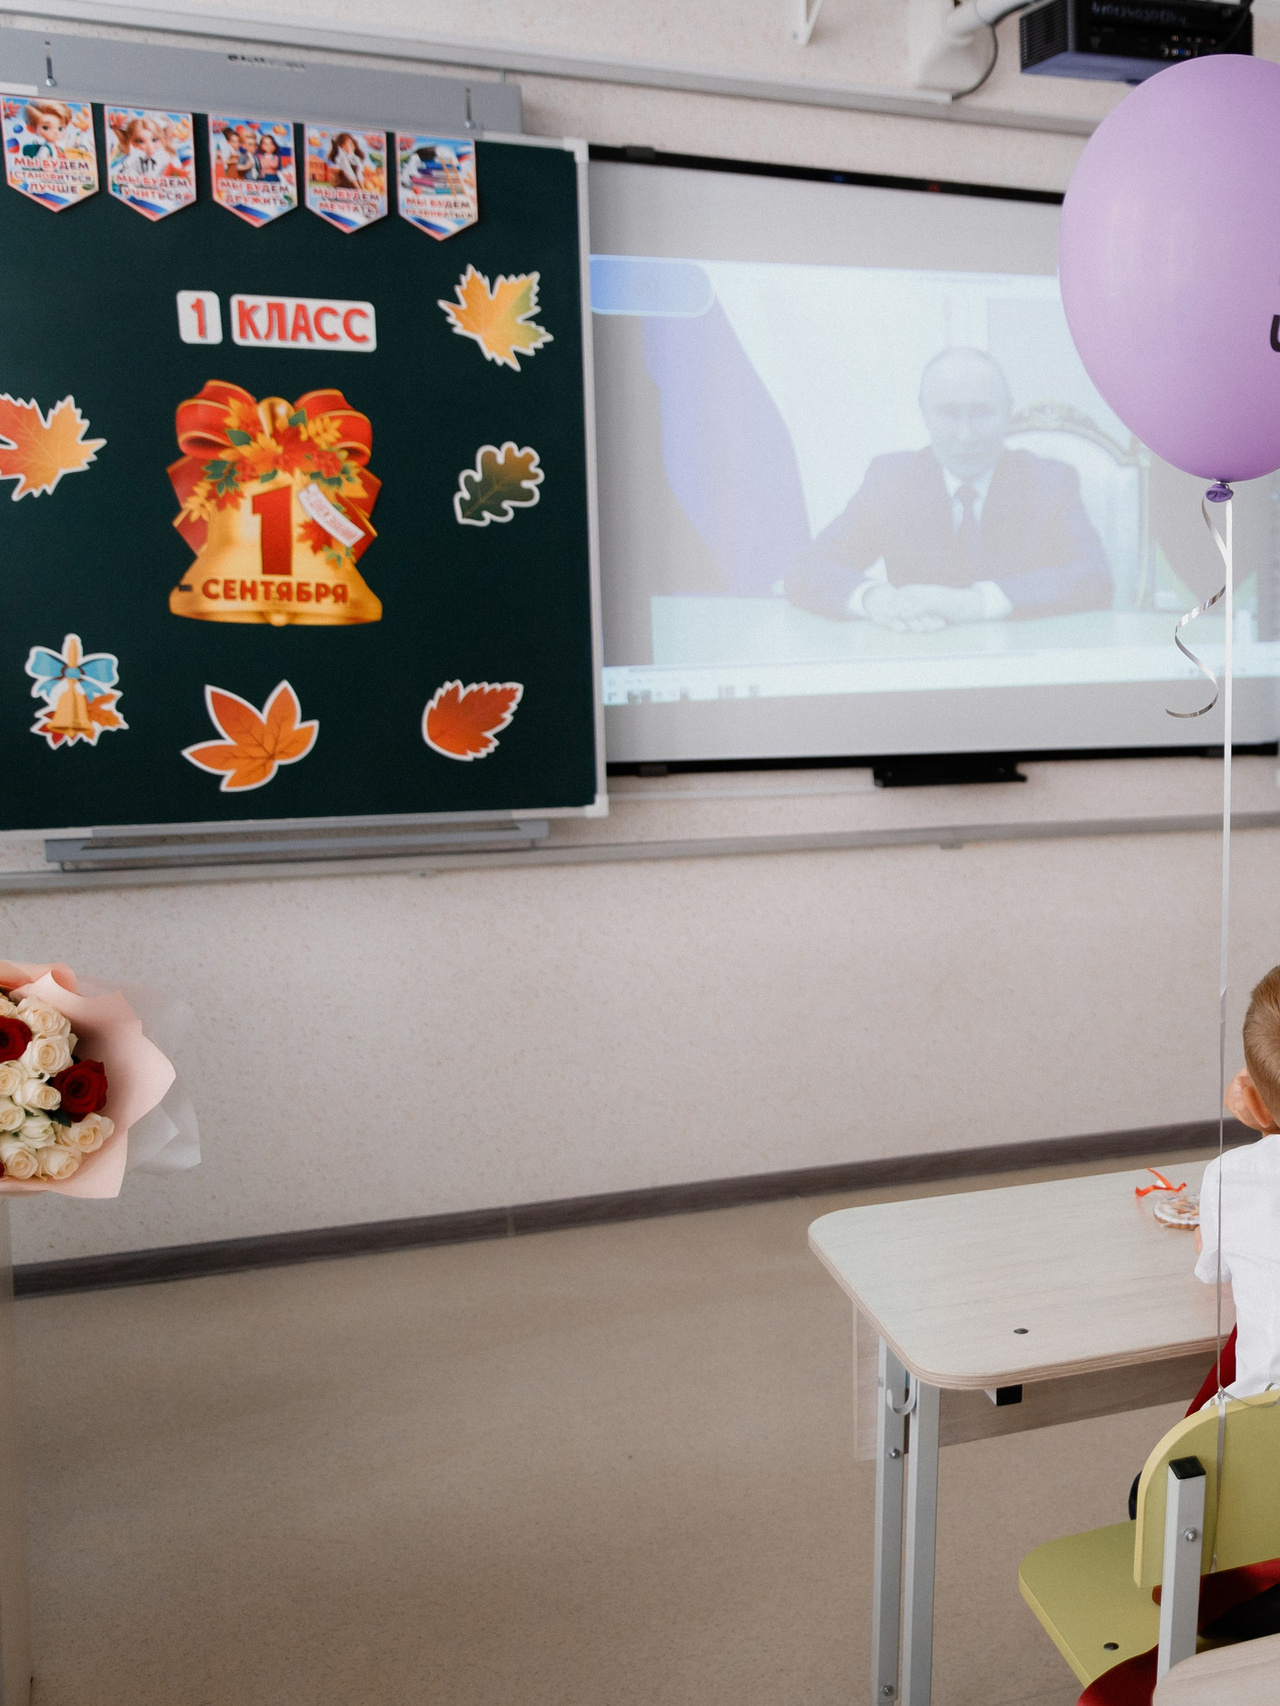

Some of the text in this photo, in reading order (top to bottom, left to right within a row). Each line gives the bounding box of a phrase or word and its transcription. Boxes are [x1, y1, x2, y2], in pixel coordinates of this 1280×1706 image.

[14, 157, 90, 170] МЫ БУДЕМ
[116, 174, 189, 188] МЫ БУДЕМ
[220, 180, 290, 193] МЫ БУДЕМ
[30, 183, 78, 194] ЛУЧШЕ
[313, 187, 380, 201] МЫ БУДЕМ
[406, 198, 470, 210] МЫ БУДЕМ
[190, 298, 369, 343] 1 КЛАСС
[251, 485, 292, 575] 1
[202, 578, 349, 605] СЕНТЯБРЯ
